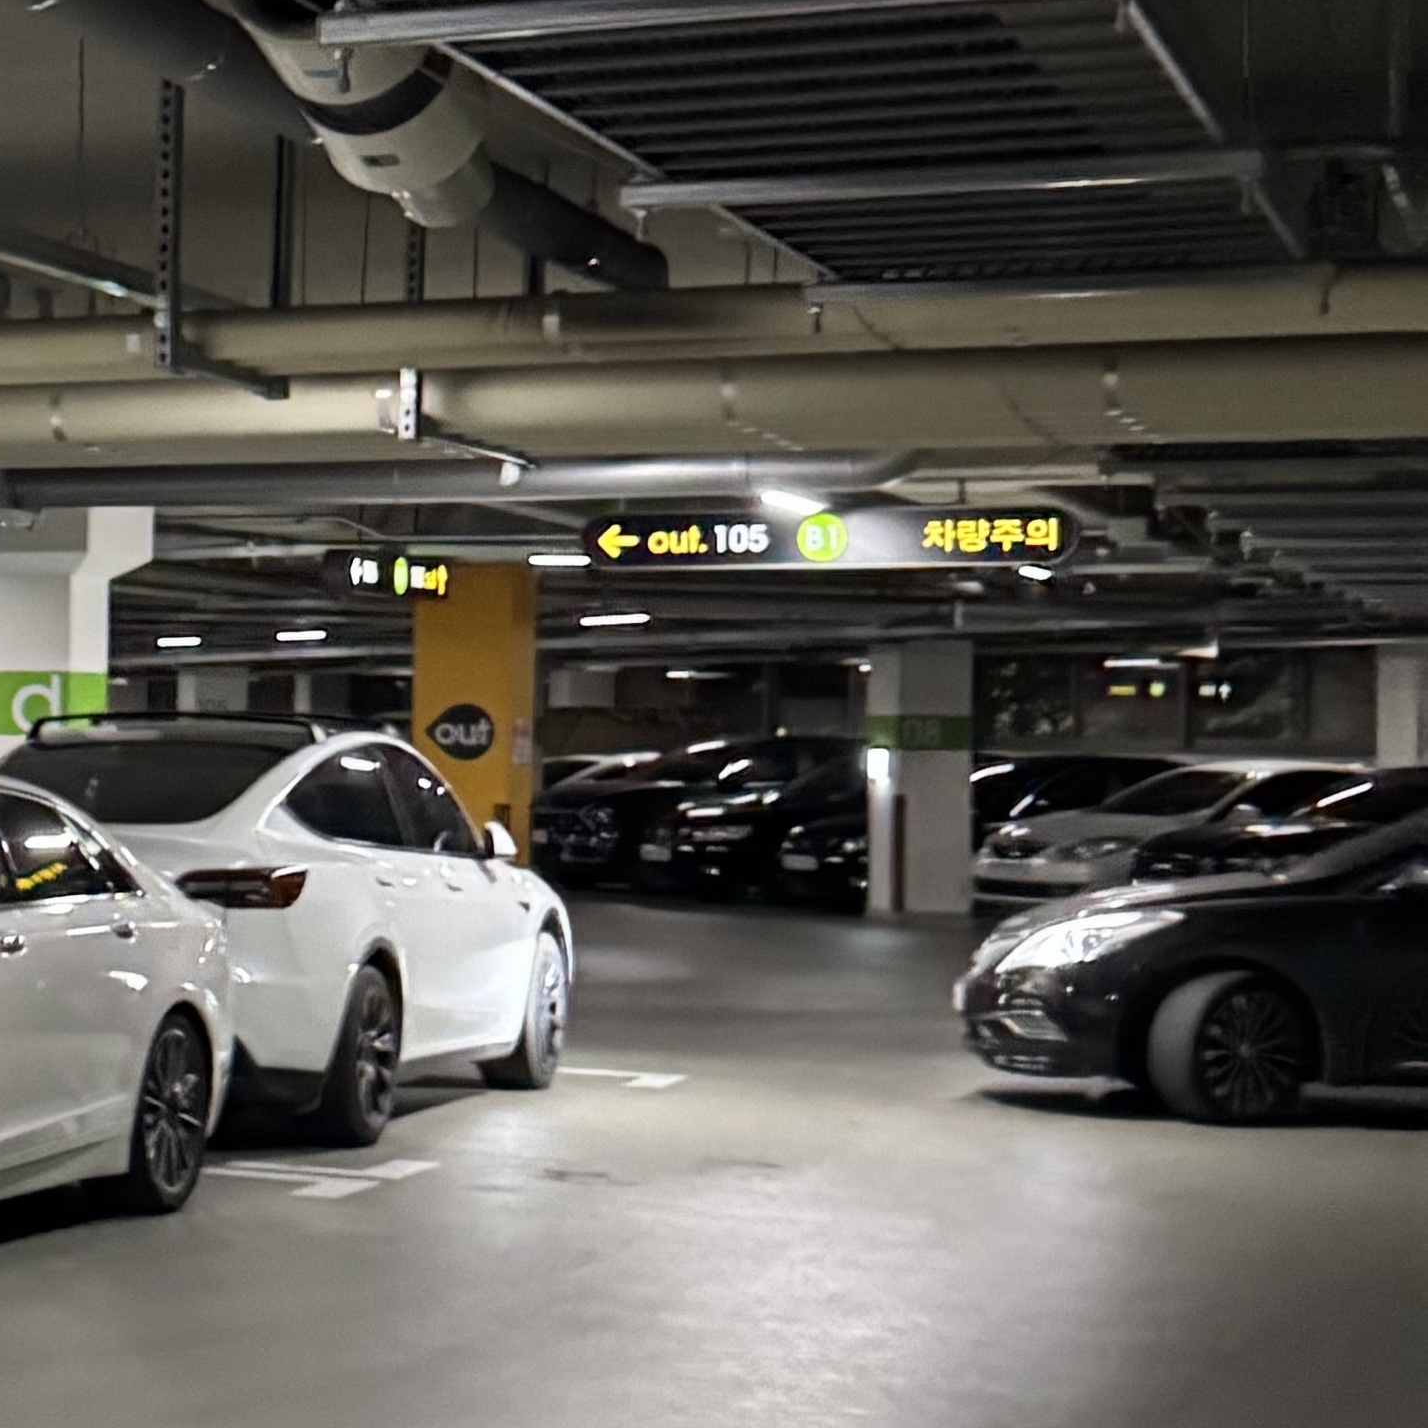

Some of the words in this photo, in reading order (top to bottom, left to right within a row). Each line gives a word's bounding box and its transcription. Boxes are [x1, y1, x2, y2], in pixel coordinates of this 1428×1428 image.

[714, 523, 771, 554] 105
[804, 524, 840, 552] B1
[922, 517, 1059, 553] 차량주의
[11, 673, 61, 732] d
[435, 718, 492, 745] out
